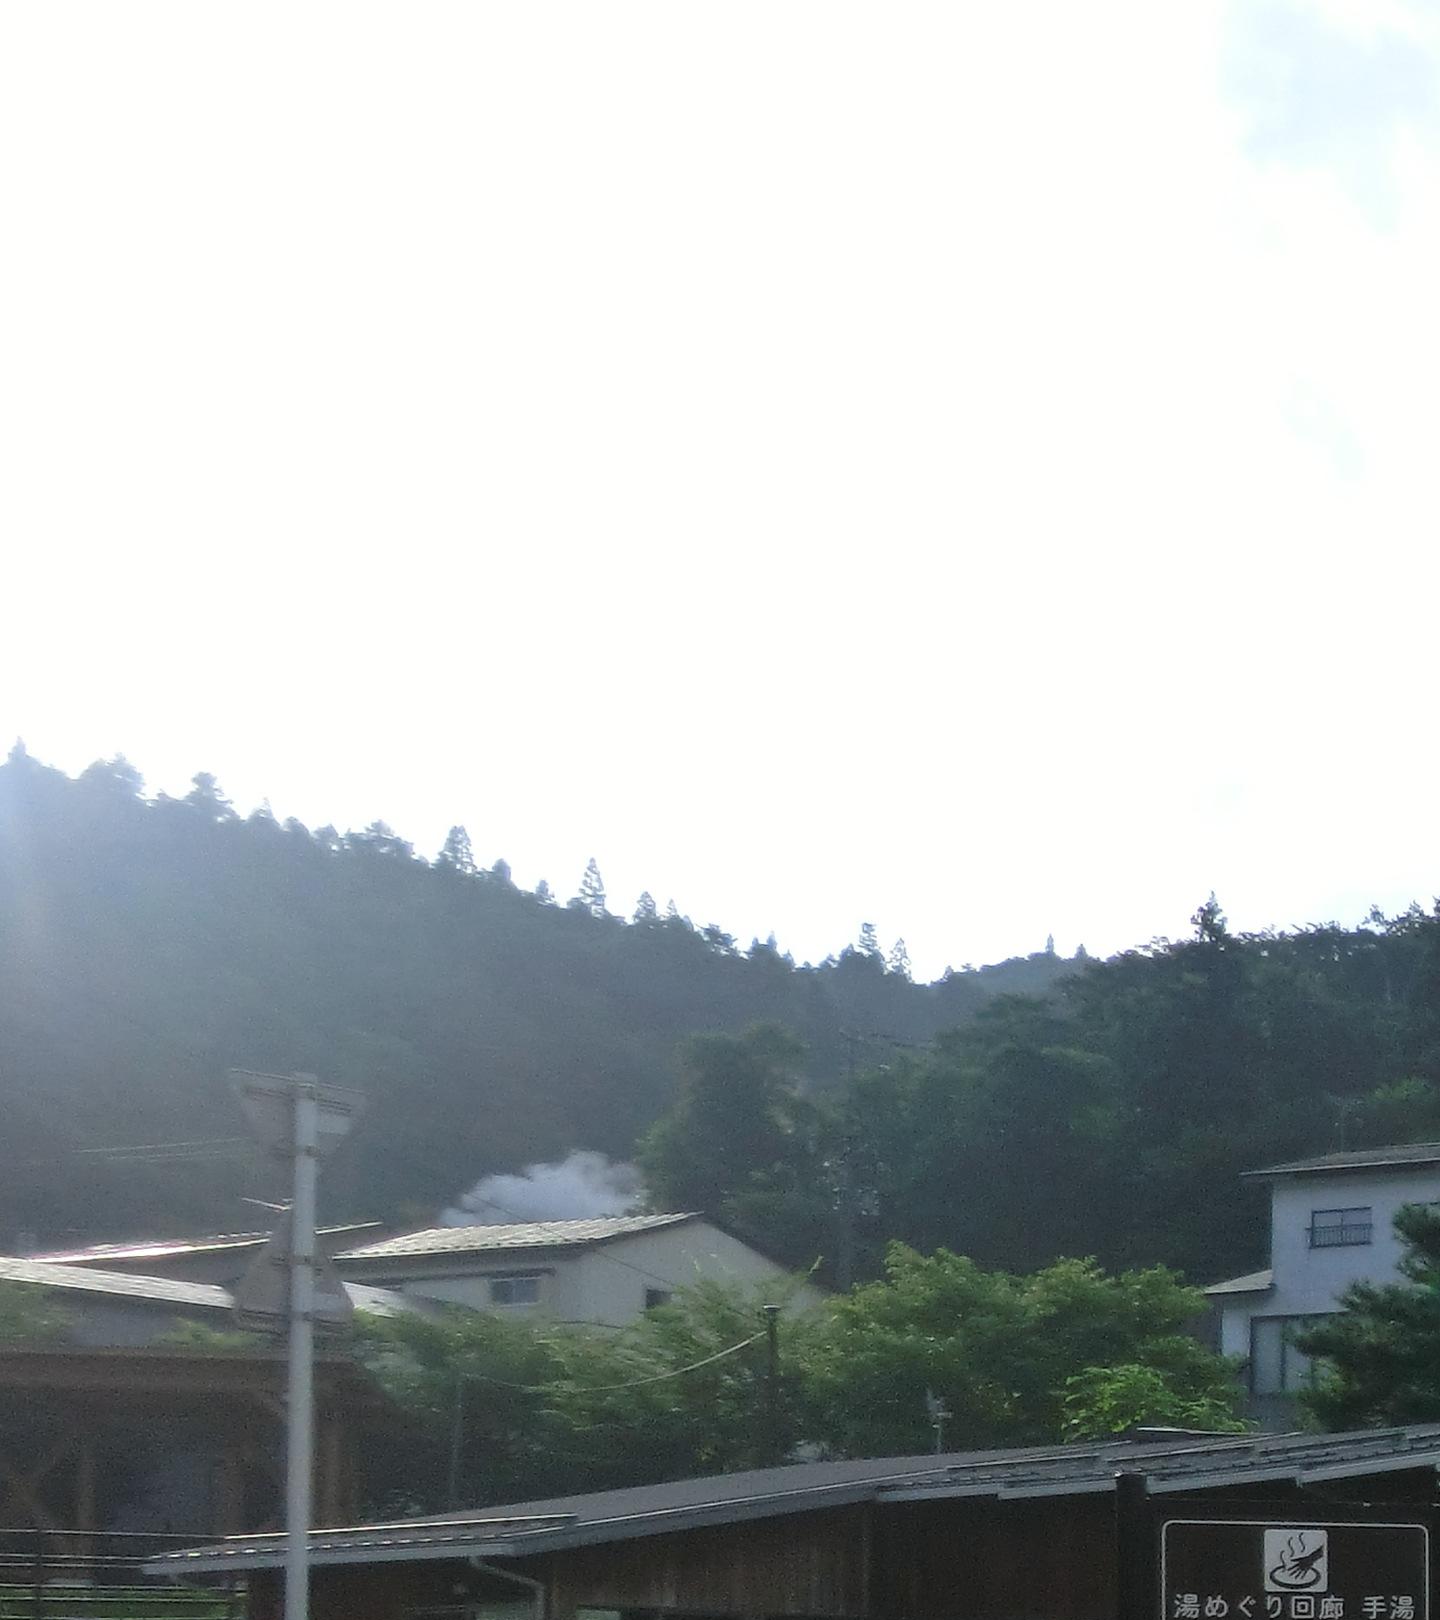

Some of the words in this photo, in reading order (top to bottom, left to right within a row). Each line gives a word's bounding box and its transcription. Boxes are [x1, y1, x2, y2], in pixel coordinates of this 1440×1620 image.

[1173, 1593, 1344, 1619] 湯めぐり回廊
[1362, 1594, 1415, 1620] 手湯
